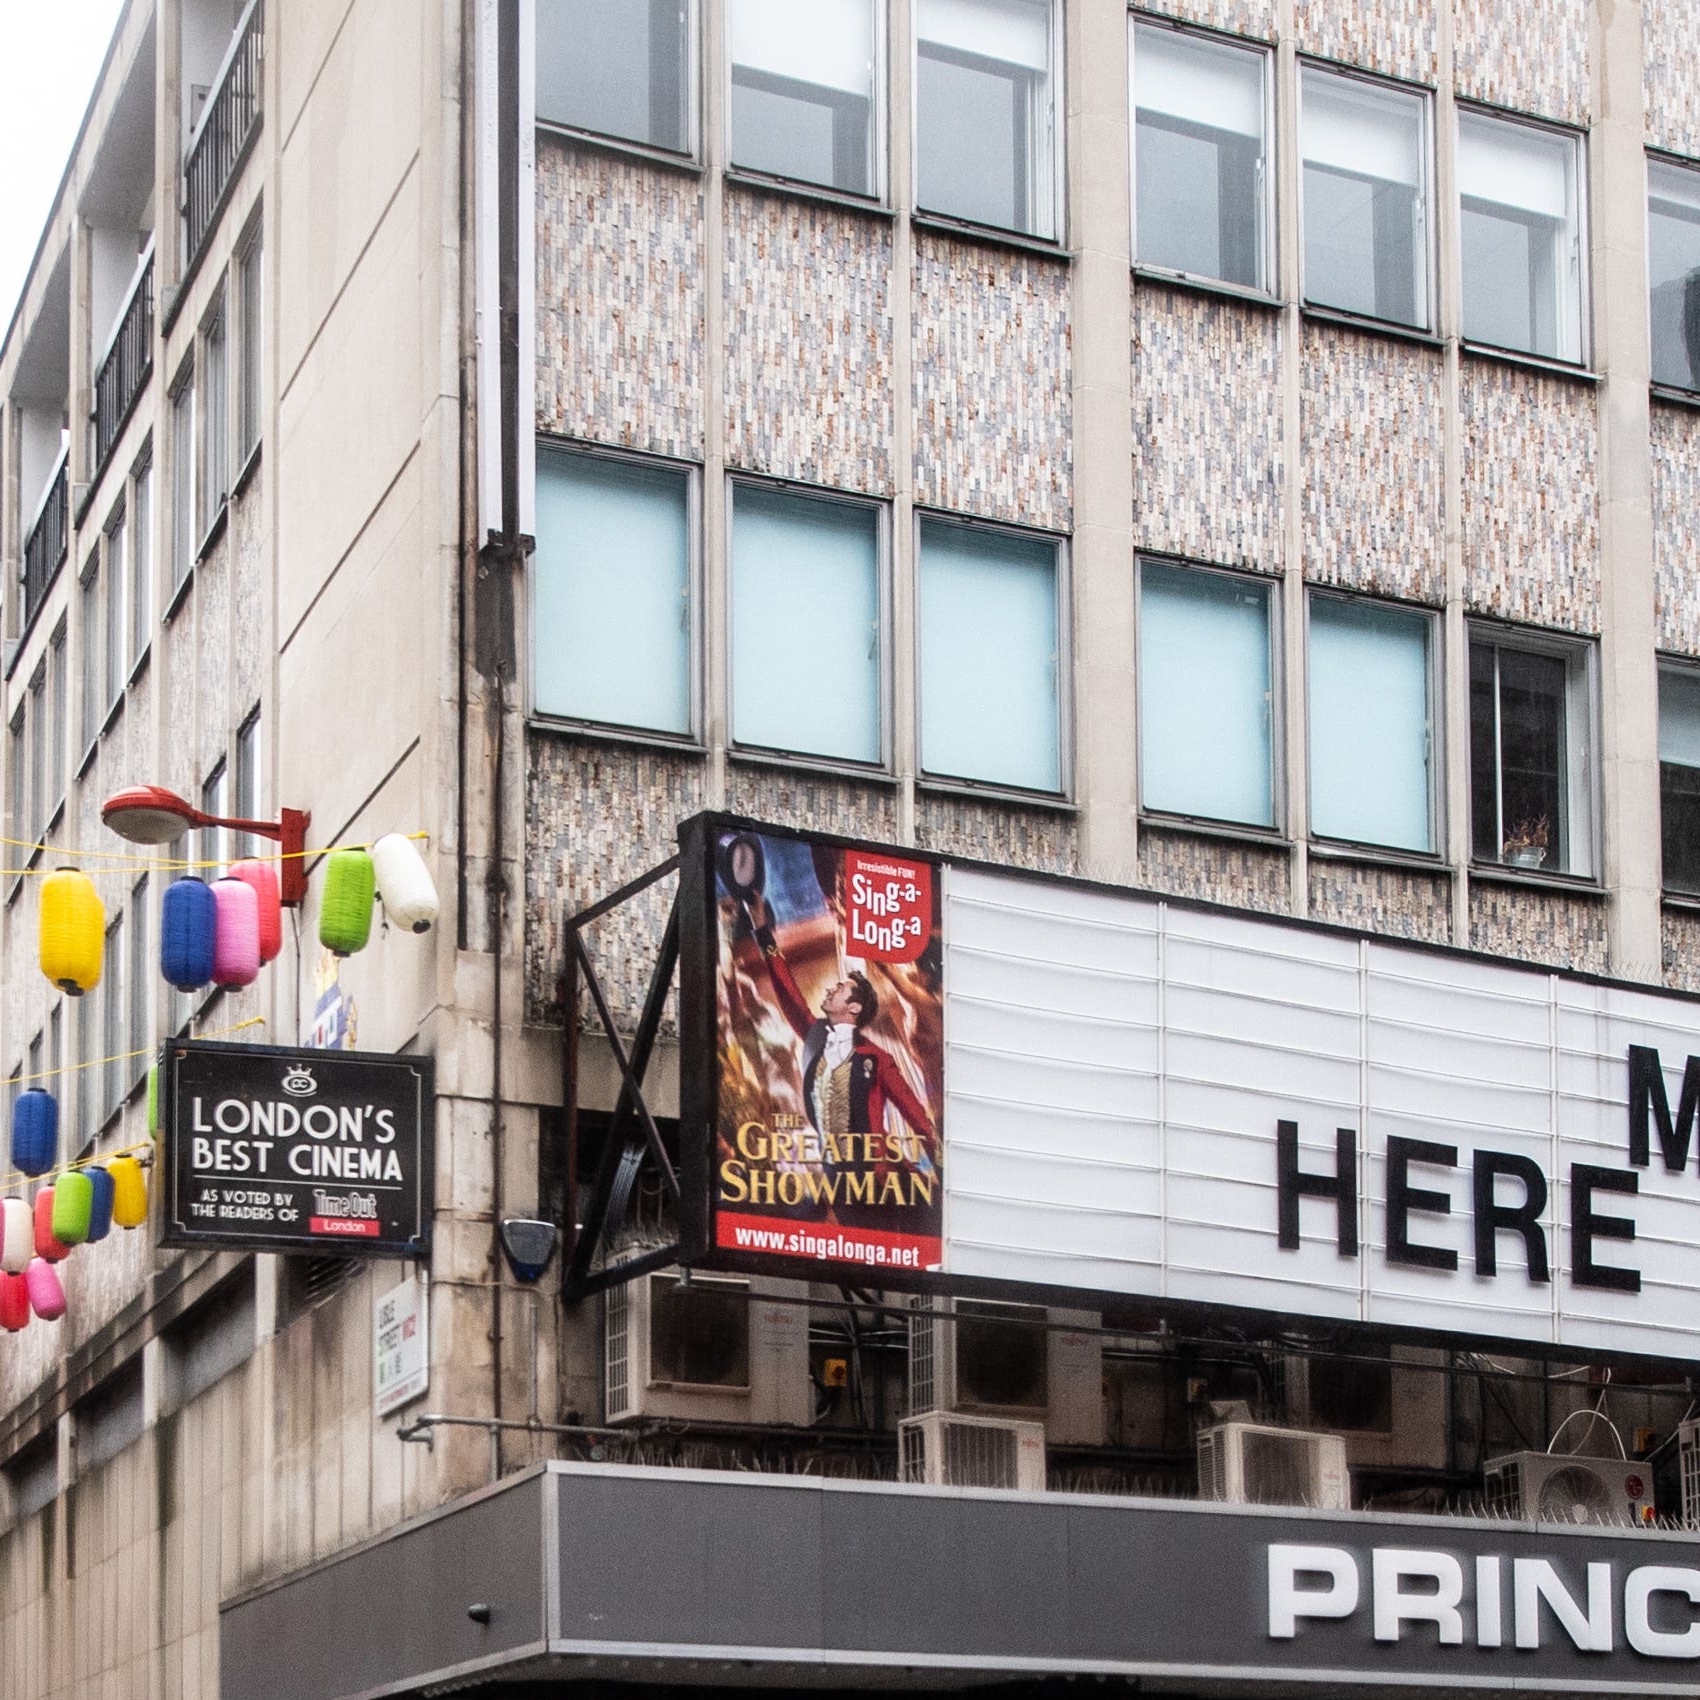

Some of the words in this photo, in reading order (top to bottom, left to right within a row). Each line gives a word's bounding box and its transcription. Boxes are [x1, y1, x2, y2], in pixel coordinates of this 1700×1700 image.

[857, 860, 898, 877] Irresistible
[852, 908, 922, 952] Long-a
[192, 1096, 397, 1144] LONDON'S
[772, 1113, 804, 1129] THE
[191, 1137, 275, 1173] BEST
[288, 1144, 404, 1182] CINEMA
[736, 1121, 927, 1163] GREATEST
[201, 1189, 219, 1202] AS
[222, 1190, 271, 1206] VOTED
[274, 1193, 294, 1207] BY
[720, 1159, 933, 1207] SHOWMAN
[190, 1203, 216, 1218] THE
[219, 1204, 275, 1221] READERS
[278, 1207, 300, 1222] OF
[312, 1188, 350, 1217] Time
[349, 1191, 378, 1219] Out
[1276, 1118, 1642, 1294] HERE
[323, 1218, 366, 1233] London
[735, 1227, 920, 1267] www.singalonga.net
